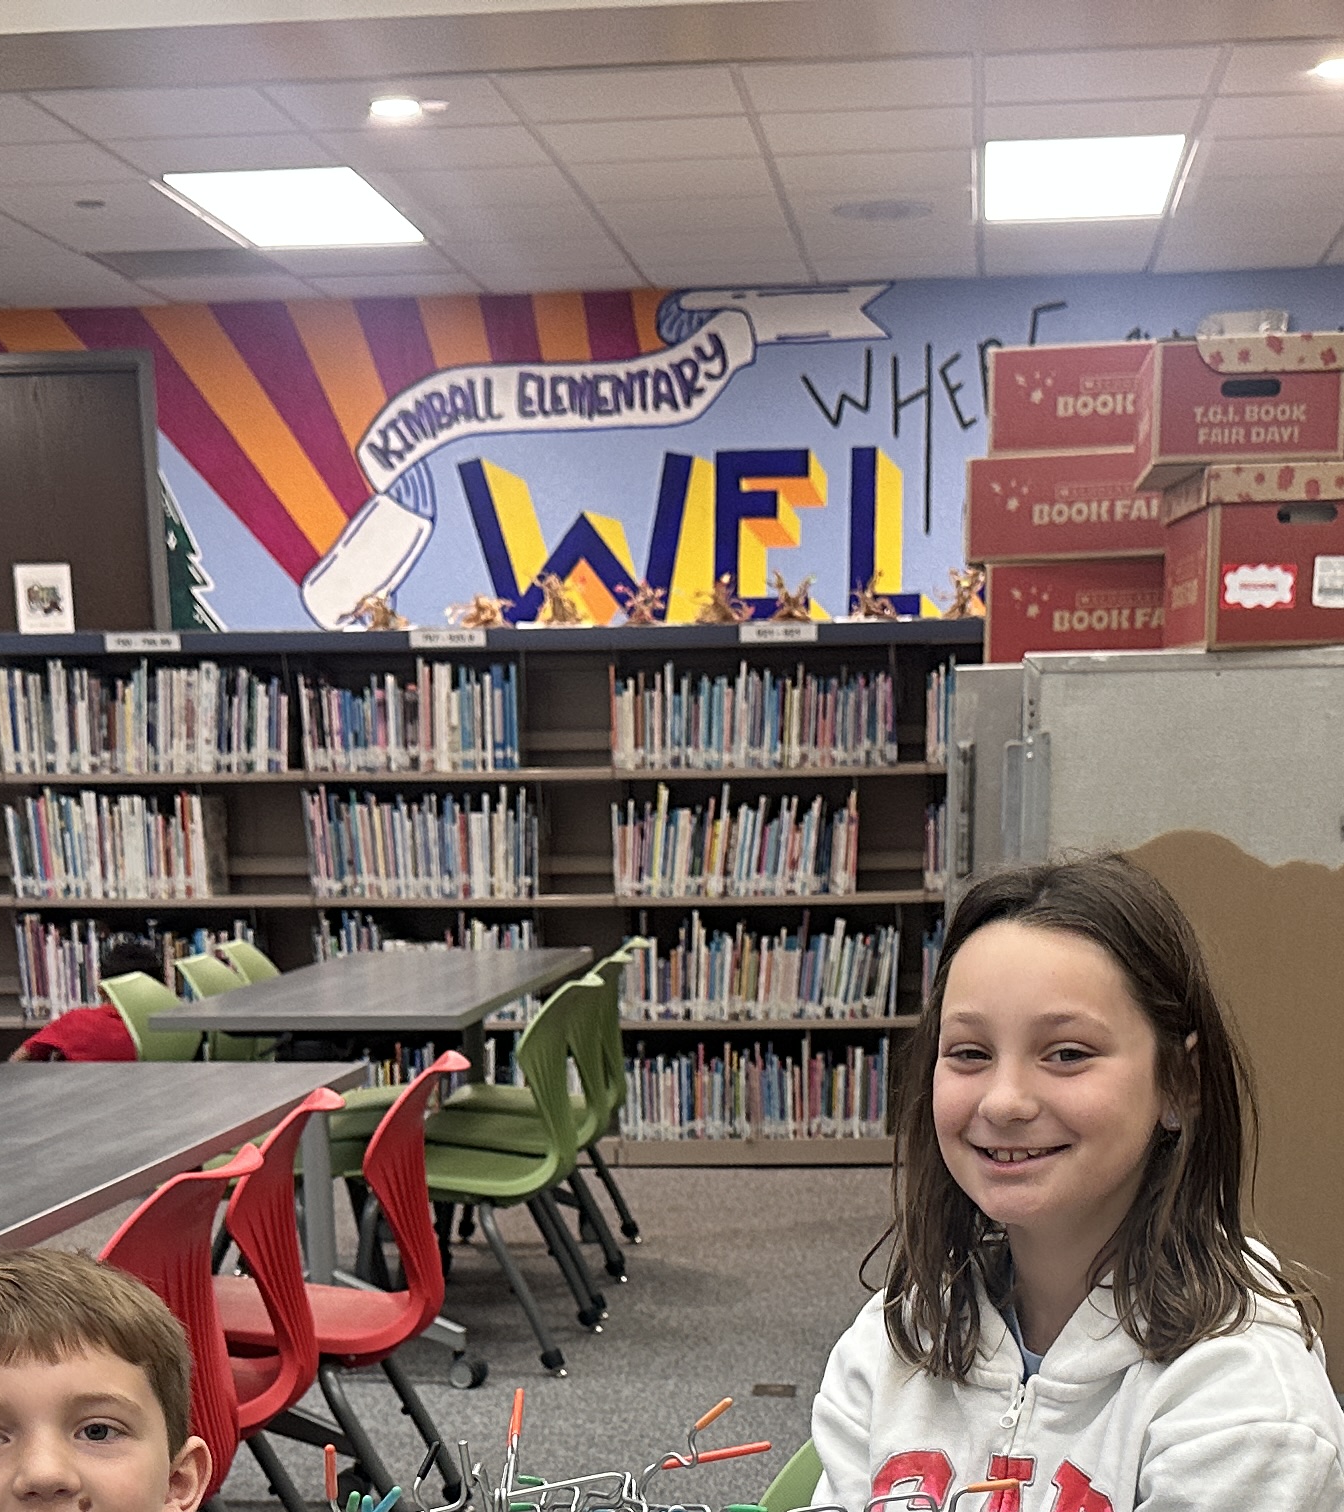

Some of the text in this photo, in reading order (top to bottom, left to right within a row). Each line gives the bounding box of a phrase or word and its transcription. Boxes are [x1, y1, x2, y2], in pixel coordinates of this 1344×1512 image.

[367, 332, 730, 471] KIMBALL ELEMENTARY
[1057, 392, 1135, 417] BOOK
[1244, 403, 1307, 422] BOOK
[1198, 425, 1300, 444] FAIR DAY!
[1032, 497, 1159, 525] BOOK FAI
[1053, 608, 1131, 632] BOOK
